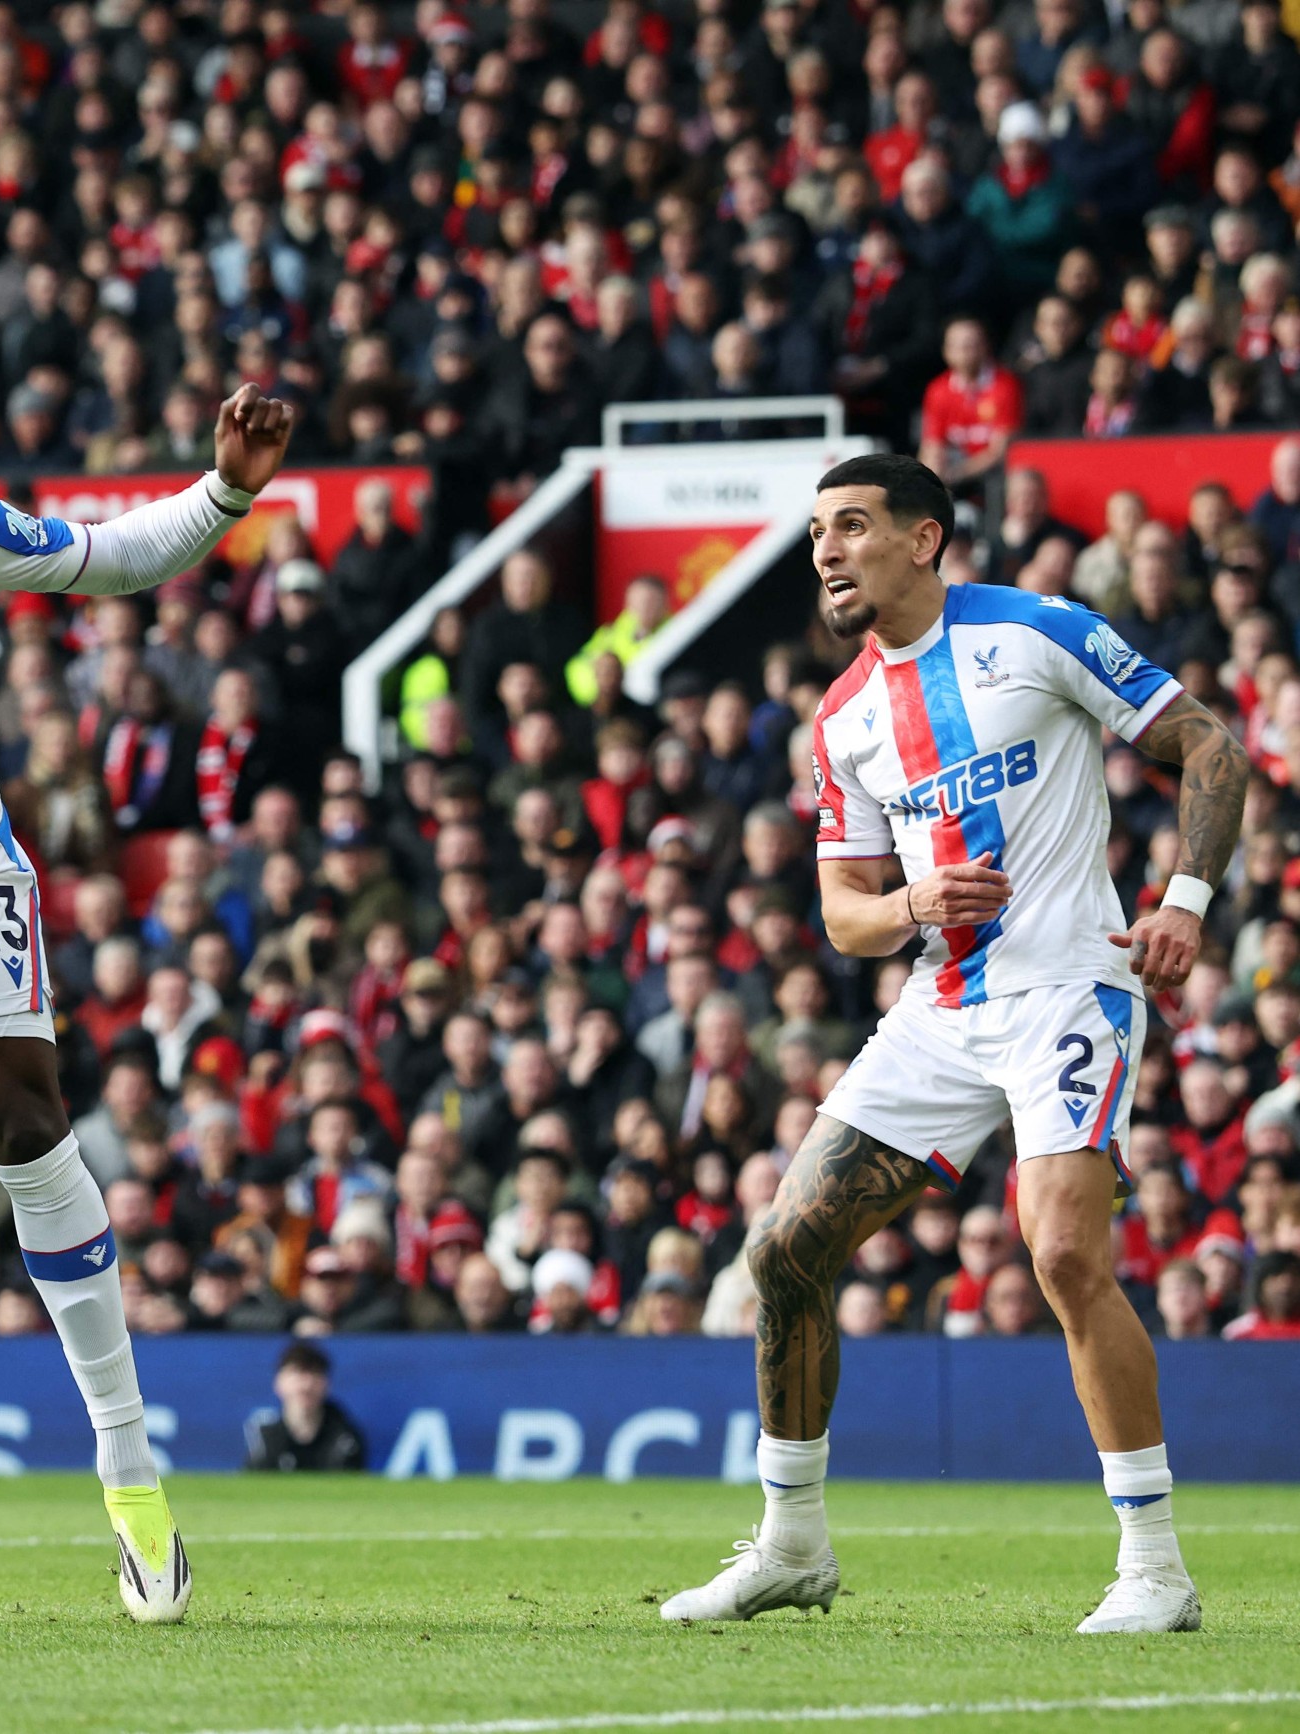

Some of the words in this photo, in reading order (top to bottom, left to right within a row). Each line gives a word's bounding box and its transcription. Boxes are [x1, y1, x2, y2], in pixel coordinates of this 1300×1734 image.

[888, 738, 1038, 826] NET88
[1056, 1033, 1098, 1096] 2
[384, 1407, 760, 1482] ARC
